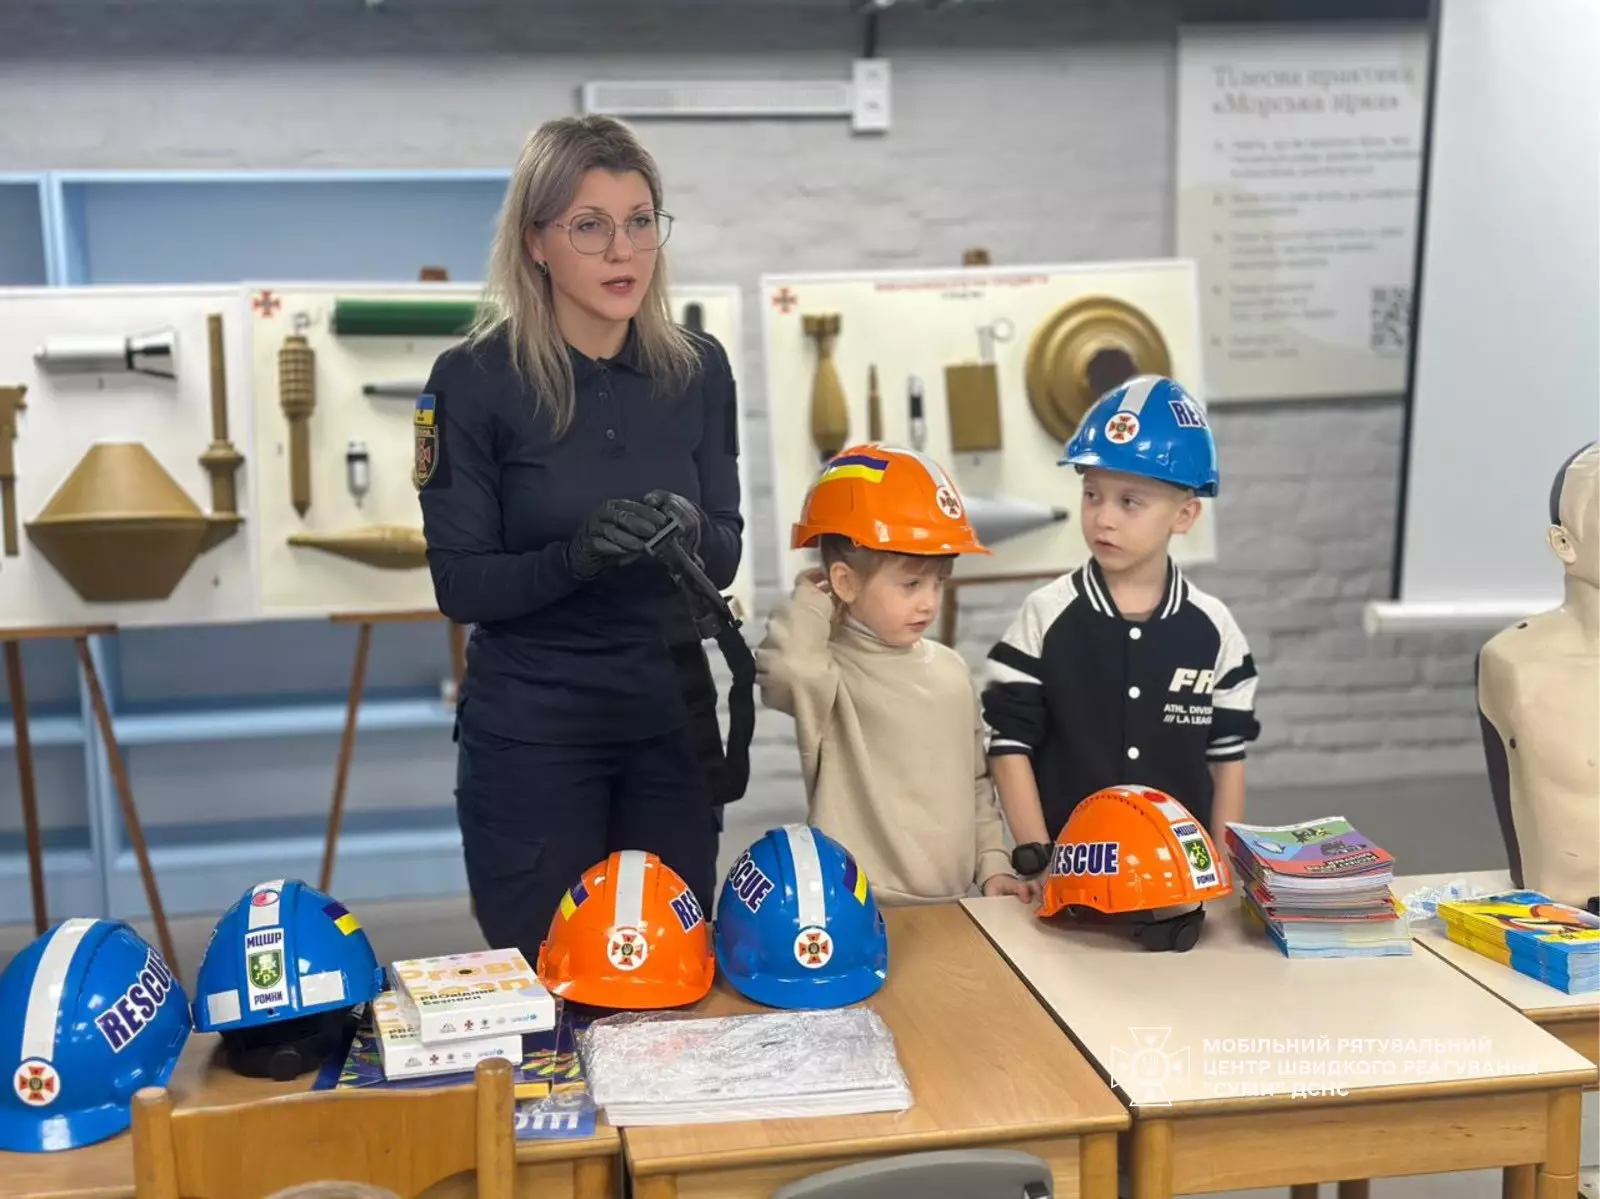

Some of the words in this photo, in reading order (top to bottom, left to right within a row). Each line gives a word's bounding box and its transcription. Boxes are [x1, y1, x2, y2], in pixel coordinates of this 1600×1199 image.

[1176, 715, 1190, 724] LA
[246, 931, 283, 949] МЦШР
[253, 990, 284, 1005] РОМНИ
